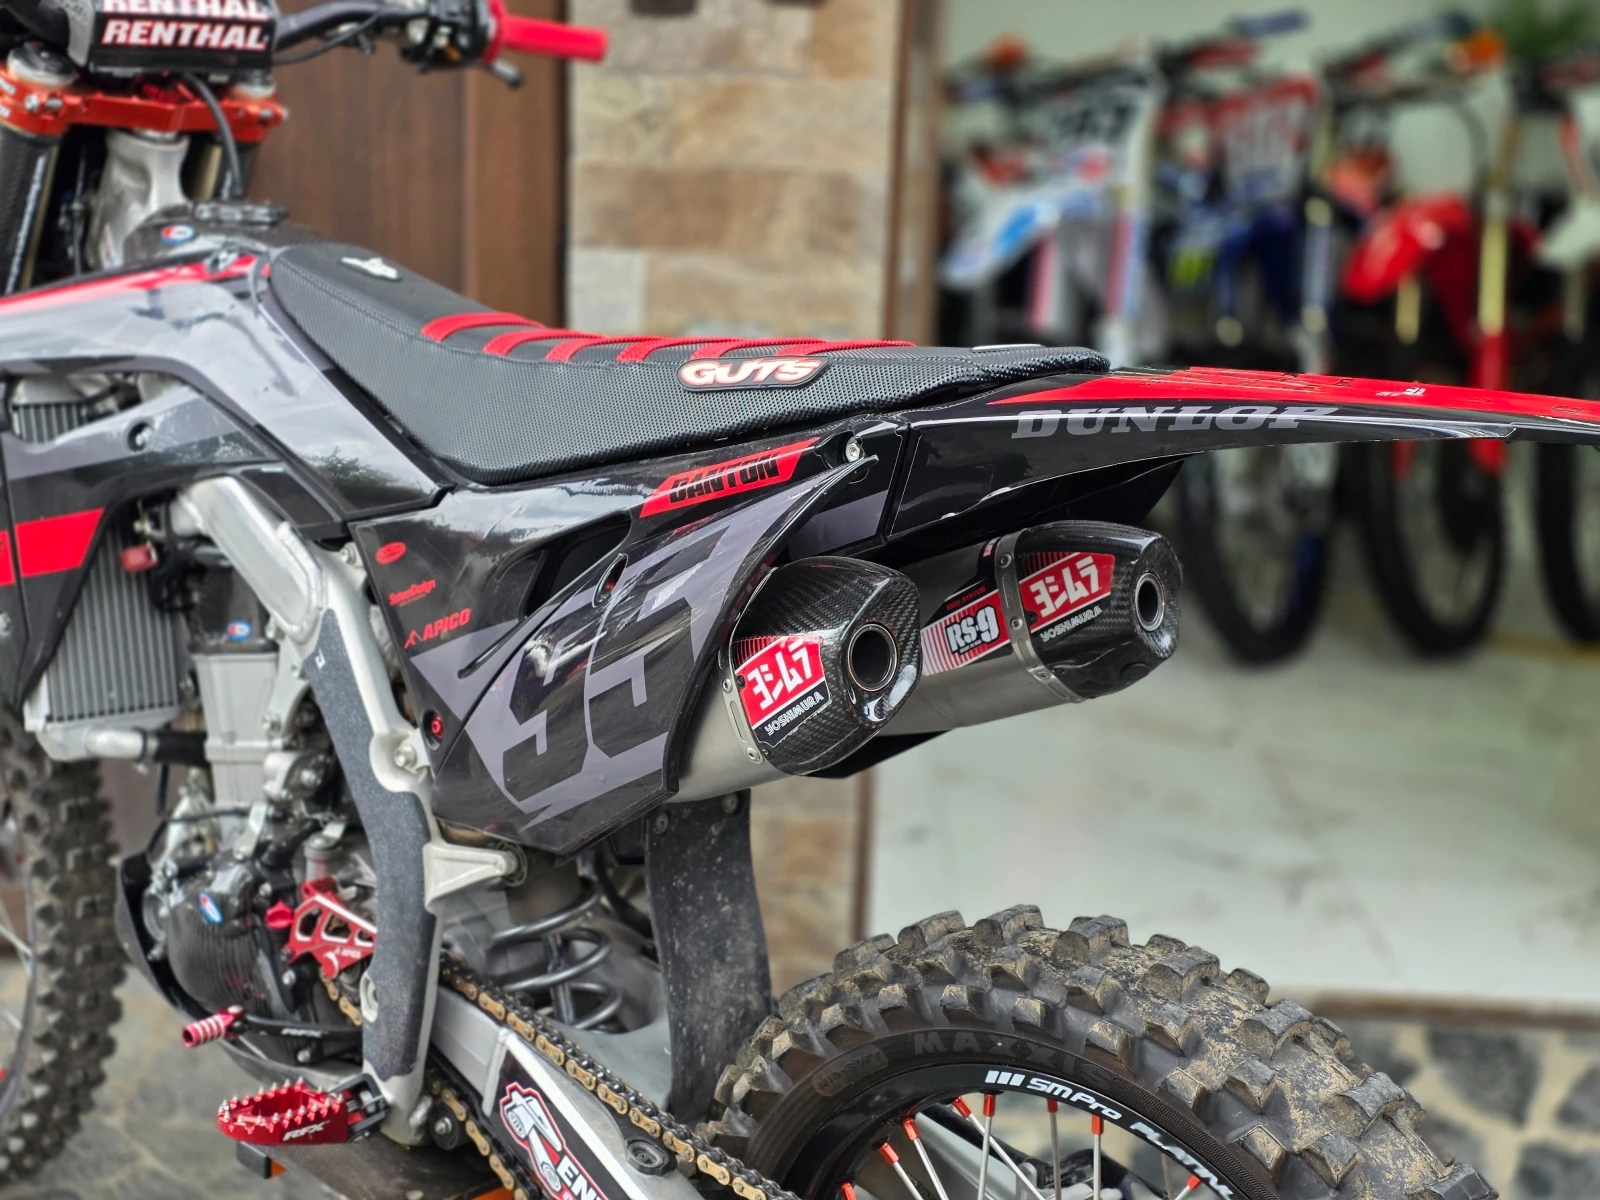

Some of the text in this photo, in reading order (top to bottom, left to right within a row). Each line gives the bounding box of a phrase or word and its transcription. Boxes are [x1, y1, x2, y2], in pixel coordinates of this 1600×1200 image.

[102, 19, 267, 50] RENTHAL
[680, 357, 822, 386] GUTS
[1011, 405, 1339, 439] DUNLOP
[423, 608, 471, 641] APICO
[1040, 606, 1103, 642] YOSHIMURA
[764, 691, 824, 736] YOSHIMURA
[913, 1031, 1110, 1092] MAXXIS
